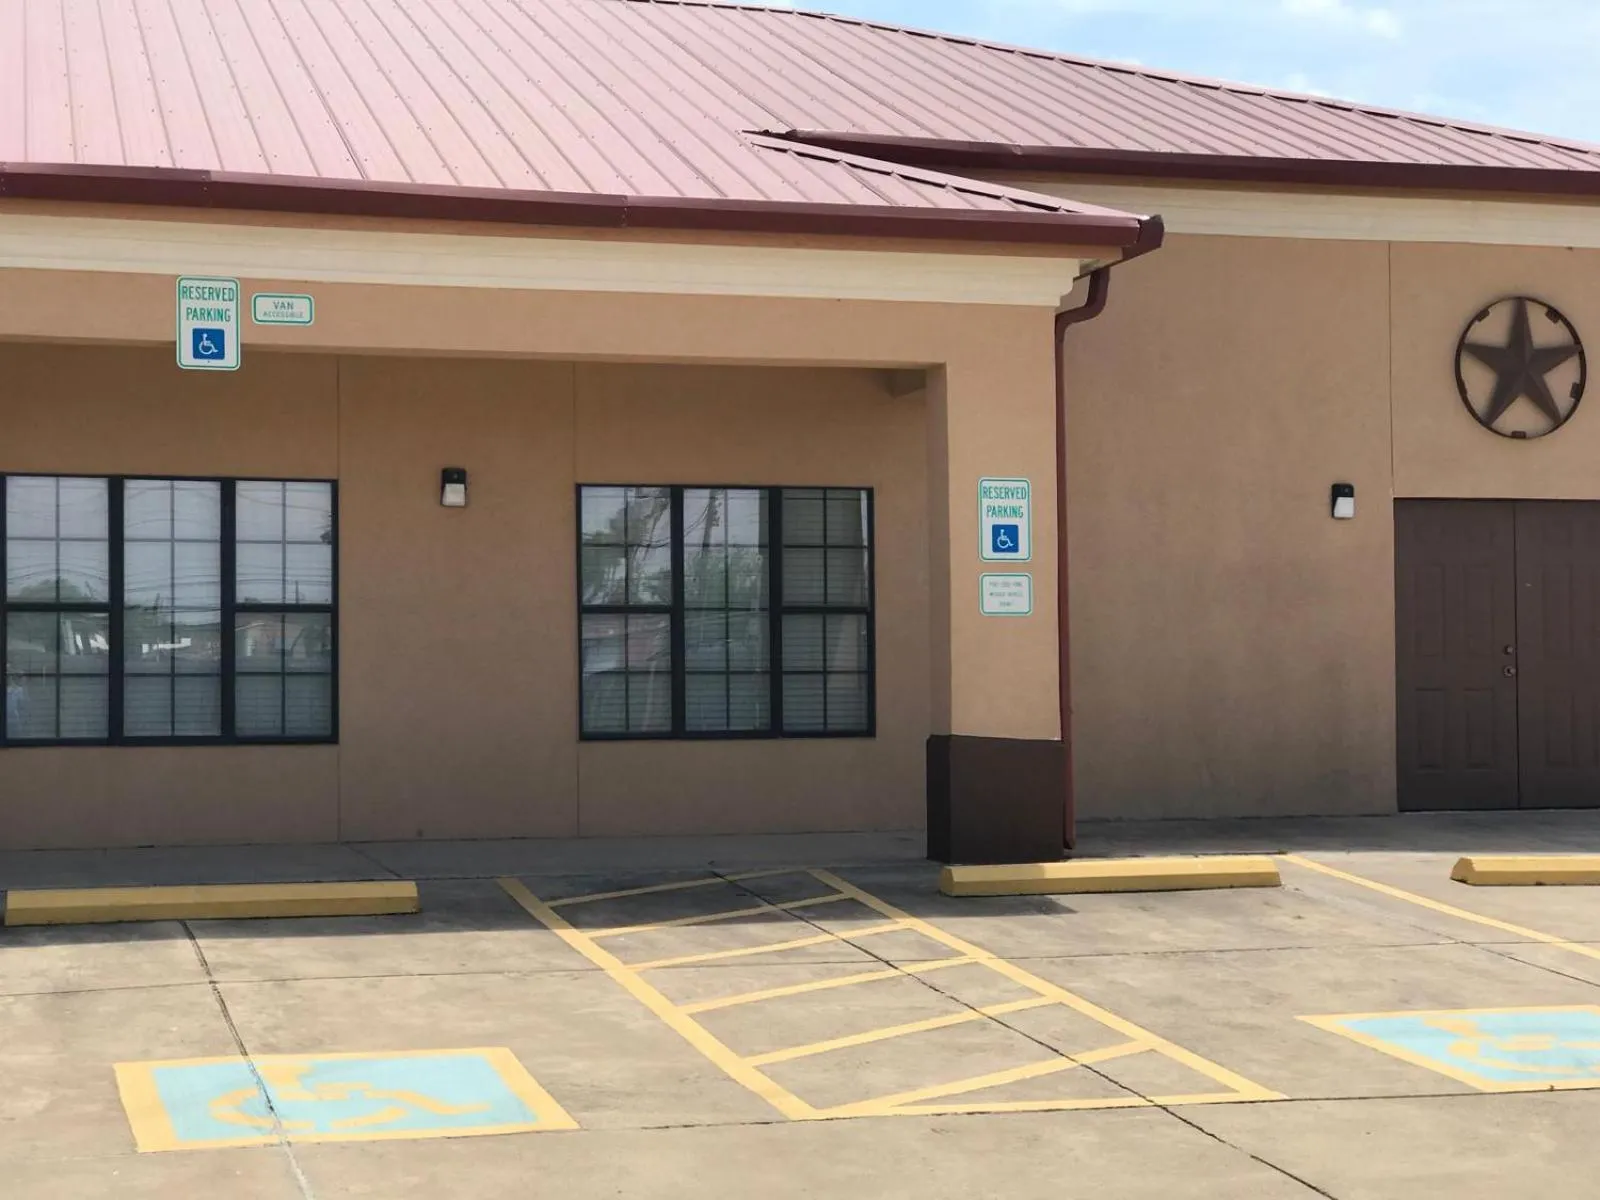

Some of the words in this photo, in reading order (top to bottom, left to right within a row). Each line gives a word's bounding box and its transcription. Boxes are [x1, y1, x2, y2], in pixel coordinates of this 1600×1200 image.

[181, 285, 235, 302] RESERVED
[272, 300, 295, 311] VAN
[186, 306, 232, 322] PARKING
[982, 486, 1027, 500] RESERVED
[986, 505, 1024, 519] PARKING
